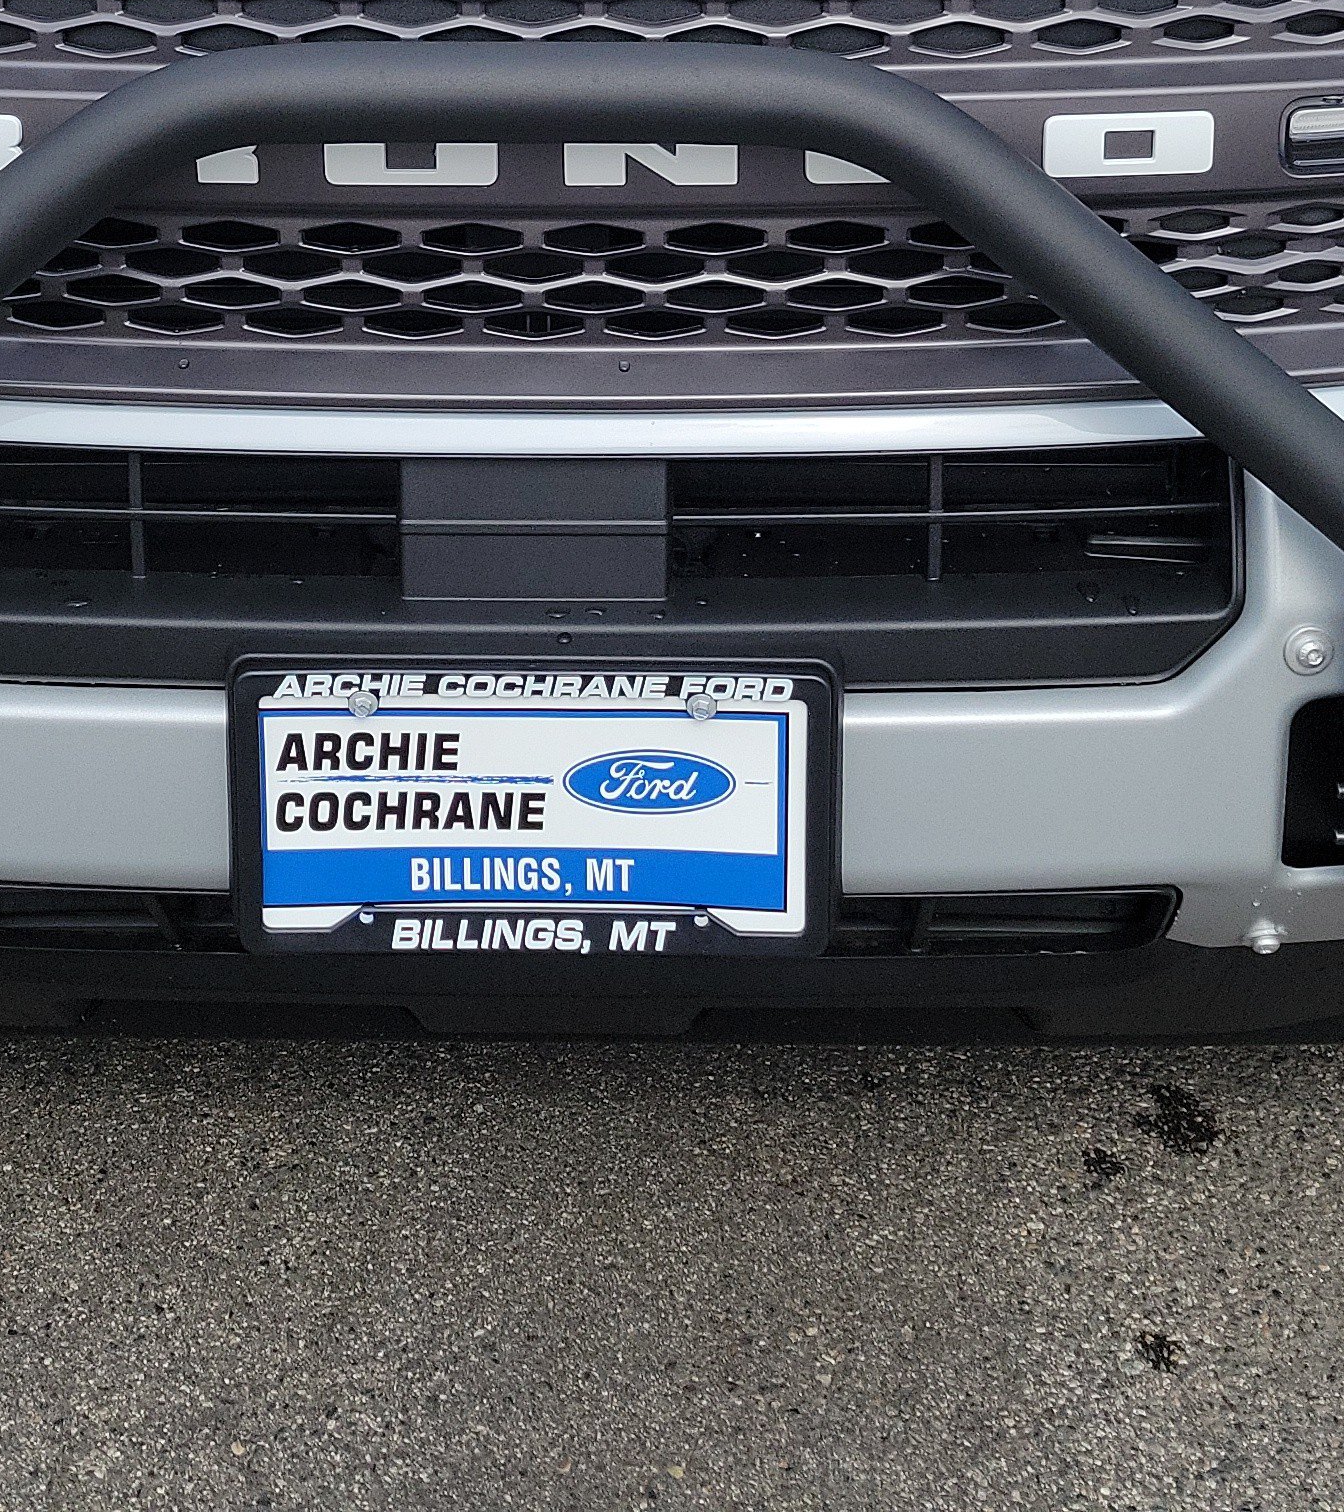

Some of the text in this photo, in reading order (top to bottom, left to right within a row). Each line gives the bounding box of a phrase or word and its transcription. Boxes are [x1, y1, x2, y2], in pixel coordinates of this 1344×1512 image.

[274, 674, 794, 702] ARCHIE COCHRANE FORD
[275, 732, 461, 773] ARCHIE
[599, 759, 699, 800] Ford
[275, 792, 546, 832] COCHRANE
[410, 856, 635, 897] BILLINGS, MT
[391, 919, 677, 954] BILLINGS, MT
